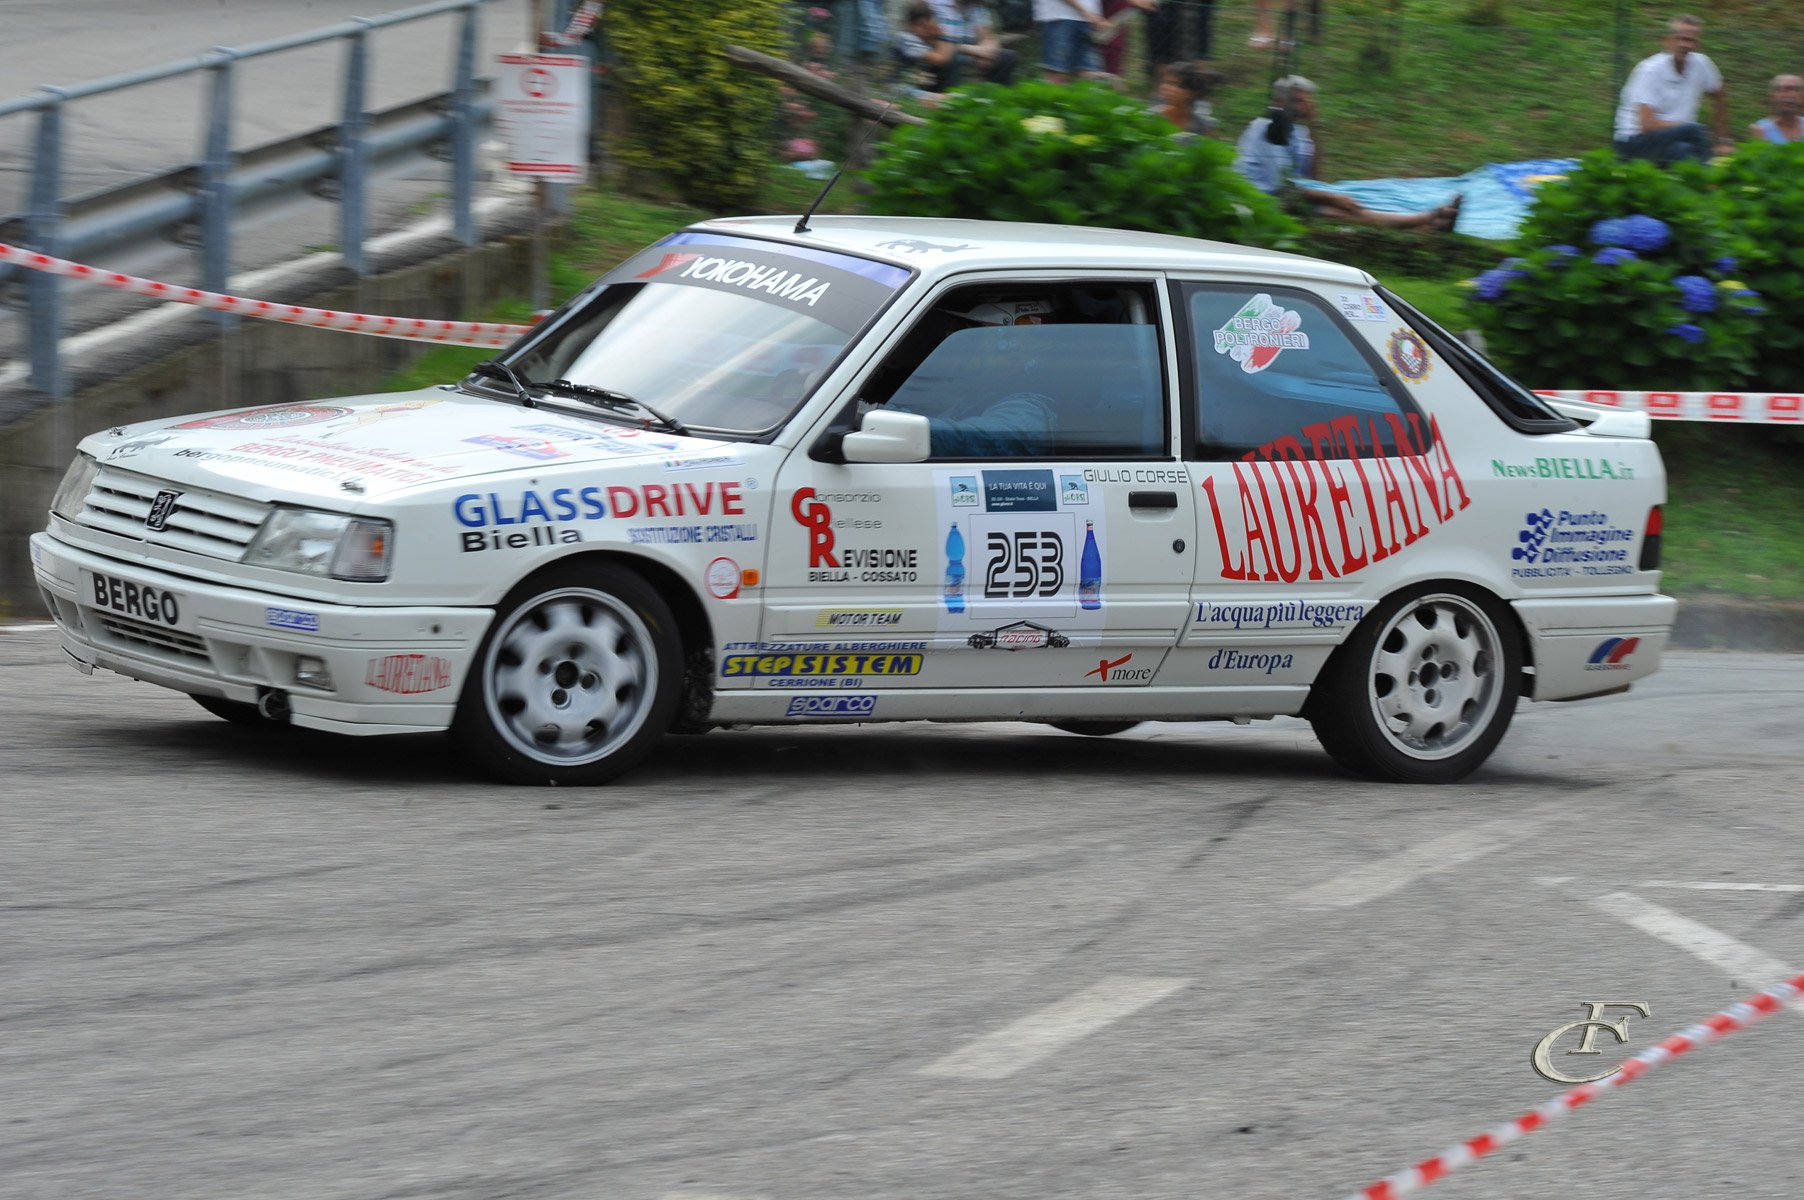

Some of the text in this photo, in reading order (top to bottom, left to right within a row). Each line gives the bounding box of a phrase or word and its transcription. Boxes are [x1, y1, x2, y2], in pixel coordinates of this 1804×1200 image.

[680, 256, 832, 307] YOKOHAMA
[1232, 316, 1281, 330] BERGO
[1213, 331, 1309, 347] POLTRONIERI
[229, 442, 311, 459] BERGO
[299, 452, 436, 484] PNEUMATICI
[1083, 469, 1188, 483] GIULIO CORSE
[998, 482, 1012, 490] TUA
[1013, 481, 1027, 490] VITA
[1034, 481, 1047, 490] QUI
[454, 482, 746, 528] GLASSDRIVE
[1202, 412, 1472, 584] LAURETANA
[1558, 511, 1608, 526] Punto
[459, 525, 584, 553] Biella
[1550, 526, 1635, 545] Immagine
[1541, 546, 1630, 563] Diffusione
[984, 531, 1064, 599] 253
[808, 571, 850, 582] BIELLA
[861, 571, 918, 582] COSSATO
[91, 571, 179, 626] BERGO
[827, 613, 903, 625] MOTOR TEAM
[1299, 600, 1365, 628] leggera
[723, 641, 928, 651] ATTREZZATURE ALBERGHIERE
[1208, 649, 1294, 675] d'Europa
[769, 678, 863, 688] CERRIONE (BI)
[790, 696, 877, 714] sparco
